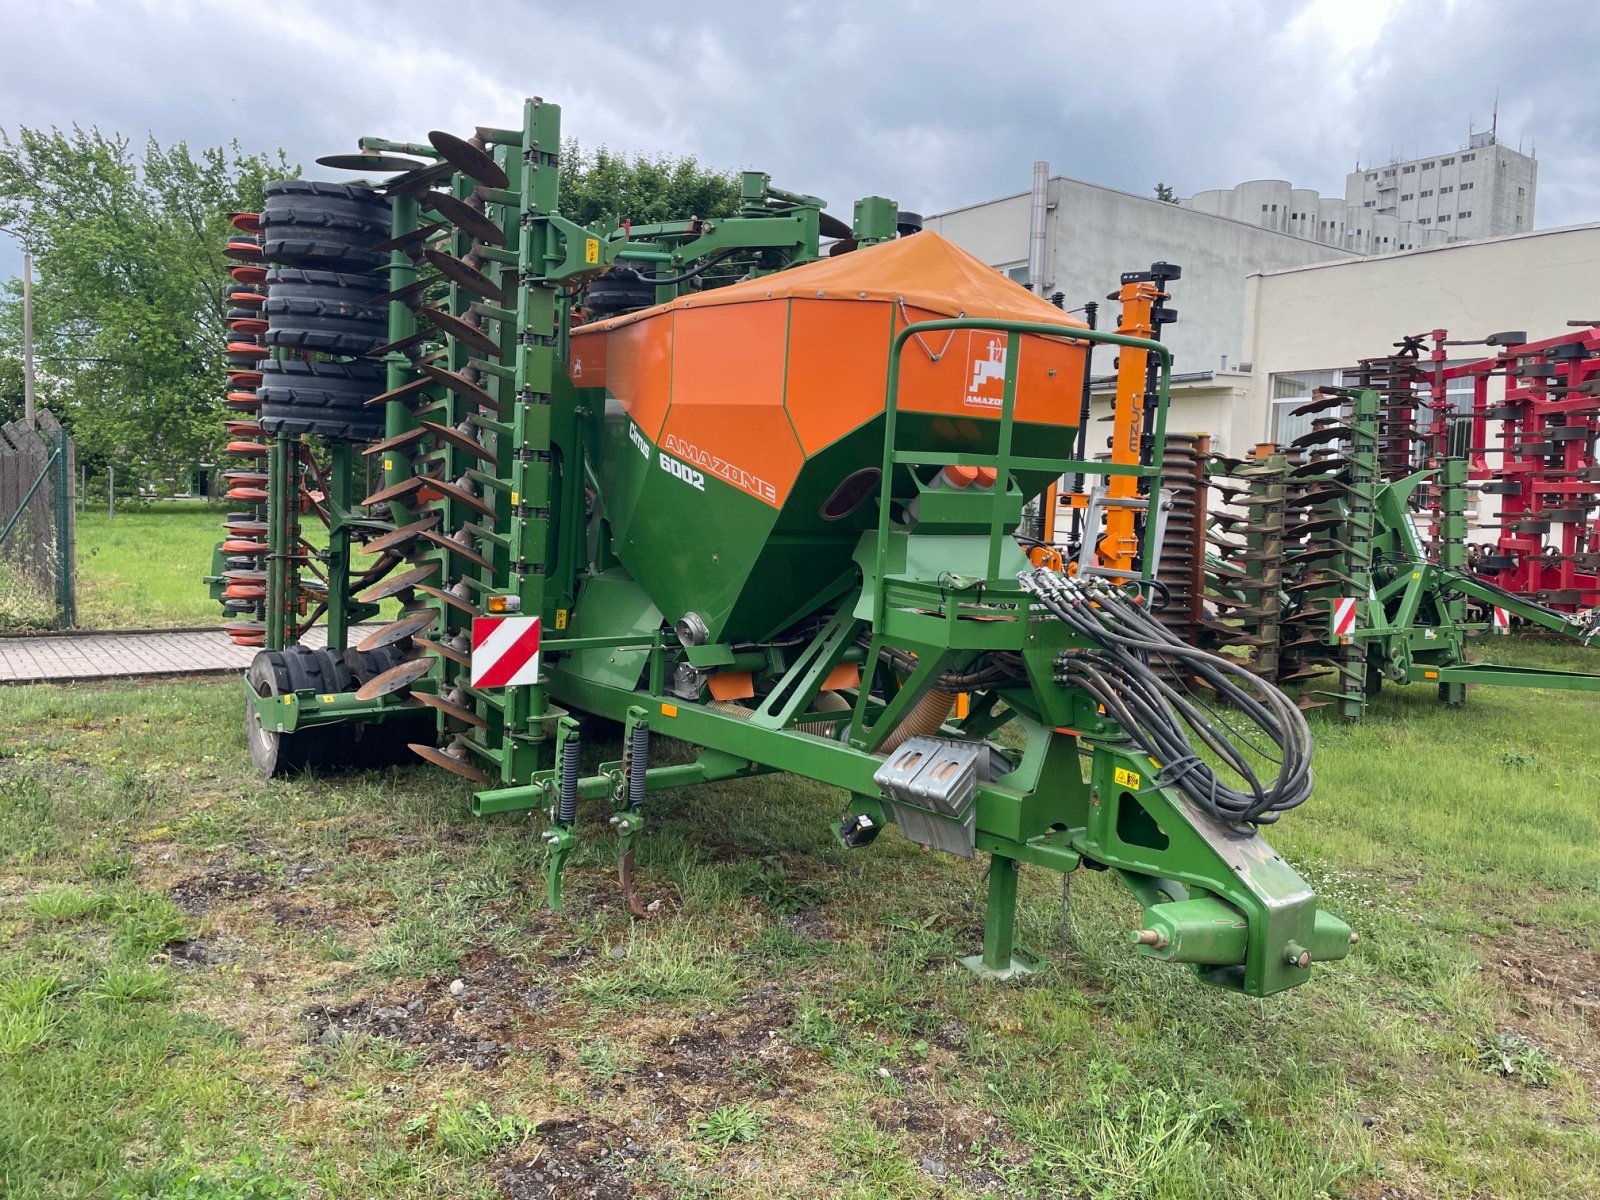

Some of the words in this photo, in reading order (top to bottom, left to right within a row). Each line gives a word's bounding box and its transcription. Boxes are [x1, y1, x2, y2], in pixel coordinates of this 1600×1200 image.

[966, 396, 1003, 406] AMAZO
[629, 421, 650, 460] Cirrus
[659, 452, 705, 492] 6002
[666, 434, 776, 503] AMAZONE
